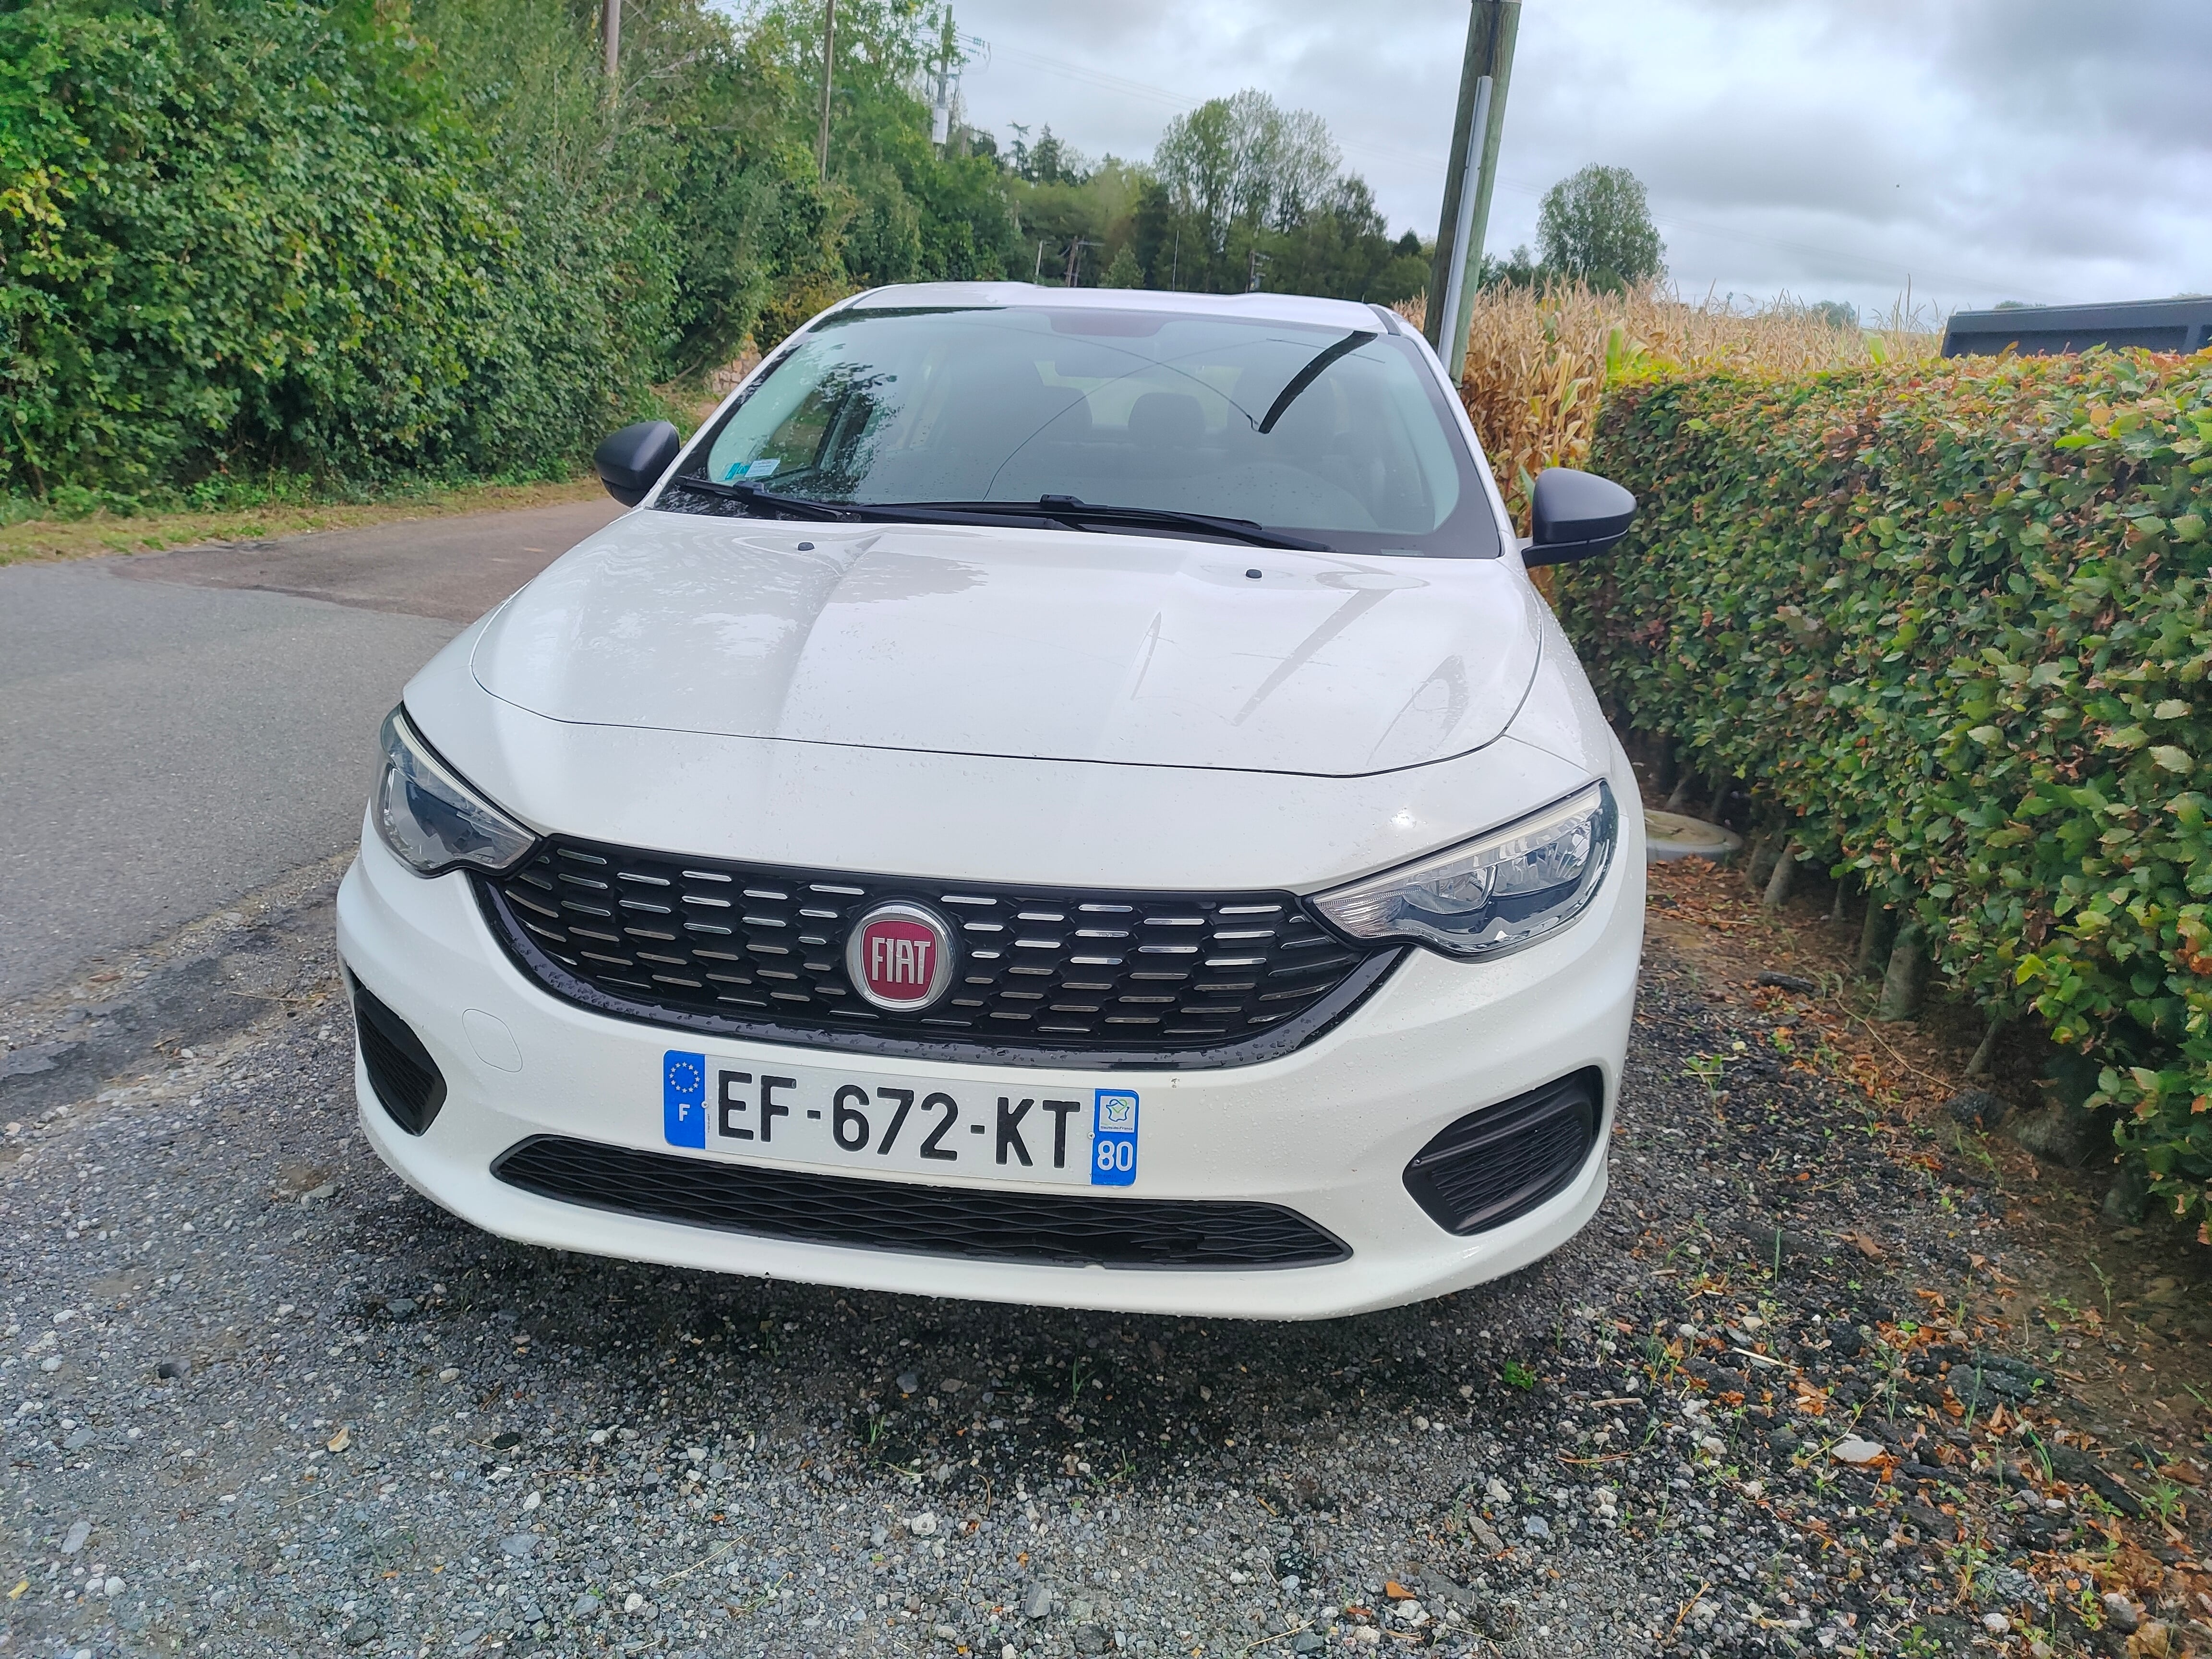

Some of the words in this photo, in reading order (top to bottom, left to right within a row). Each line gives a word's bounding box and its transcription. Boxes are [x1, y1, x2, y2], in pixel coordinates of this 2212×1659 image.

[872, 937, 931, 985] FIAT
[678, 1104, 690, 1121] F
[717, 1069, 1081, 1169] EF-672-KT
[1097, 1141, 1133, 1171] 80
